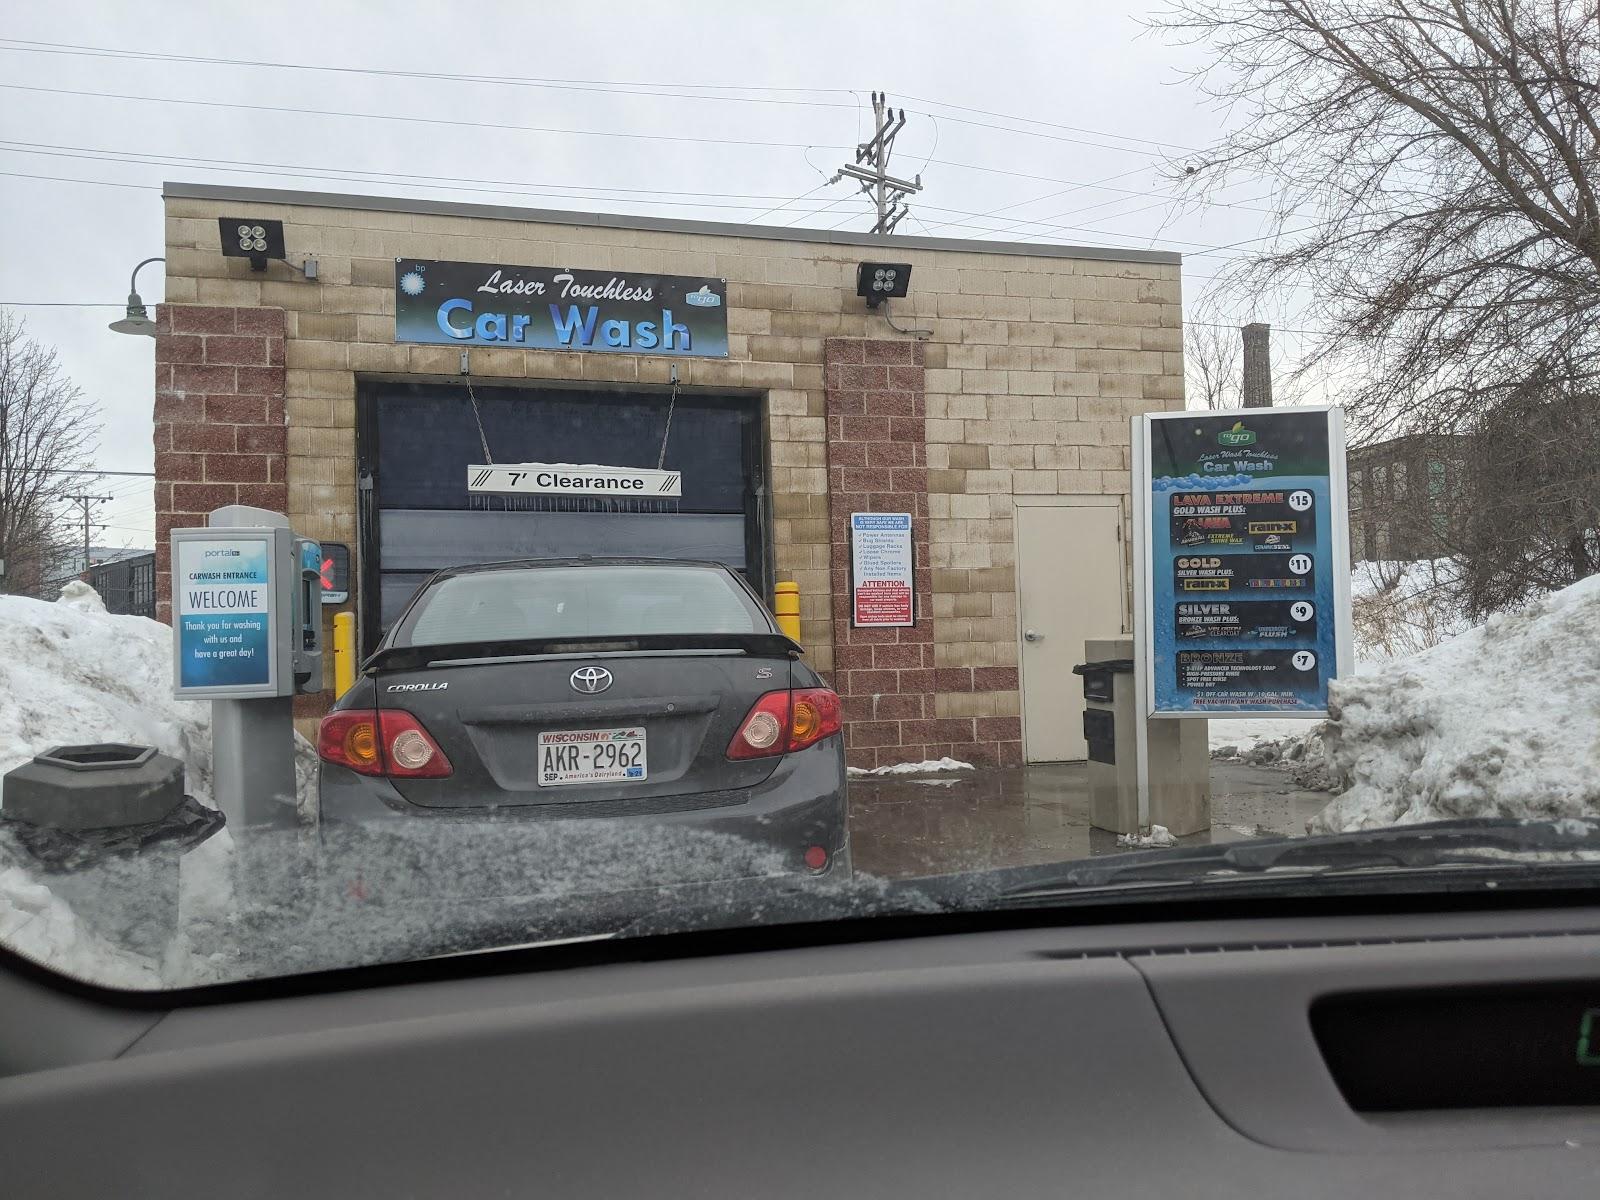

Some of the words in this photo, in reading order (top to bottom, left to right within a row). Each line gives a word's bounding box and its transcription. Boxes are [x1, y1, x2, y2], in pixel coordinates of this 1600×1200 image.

[415, 264, 426, 273] bp
[477, 270, 547, 295] Laser
[553, 274, 654, 302] Touchless
[436, 298, 532, 341] Car
[547, 303, 692, 351] Wash
[1220, 450, 1243, 459] Wash
[1243, 450, 1279, 460] Touchless
[1203, 462, 1230, 472] Car
[1234, 460, 1273, 472] Wash
[508, 472, 527, 487] 7'
[536, 473, 644, 490] Clearance
[1173, 494, 1211, 506] LAVA
[1216, 492, 1284, 505] EXTREME
[1291, 495, 1309, 506] $15
[1174, 506, 1196, 515] GOLD
[1197, 506, 1222, 514] WASH
[1222, 506, 1247, 514] PLUS:
[205, 548, 232, 558] portal
[1178, 558, 1222, 568] GOLD
[1291, 559, 1309, 570] $11
[189, 572, 221, 580] CARWASH
[223, 571, 257, 580] ENTRANCE
[189, 590, 258, 609] WELCOME
[1178, 604, 1231, 615] SILVER
[1296, 606, 1307, 618] $9
[185, 622, 205, 630] Thank
[207, 624, 220, 632] you
[222, 622, 232, 630] for
[233, 621, 261, 631] washing
[204, 635, 218, 644] with
[230, 634, 242, 643] and
[194, 649, 210, 658] have
[218, 650, 238, 660] great
[239, 648, 254, 658] day!
[1180, 652, 1244, 664] BRONZE
[1297, 656, 1308, 666] $7
[387, 682, 448, 692] COROLLA
[542, 732, 600, 743] WISCONSIN
[543, 742, 642, 772] AKR-2962
[544, 773, 558, 781] SEP
